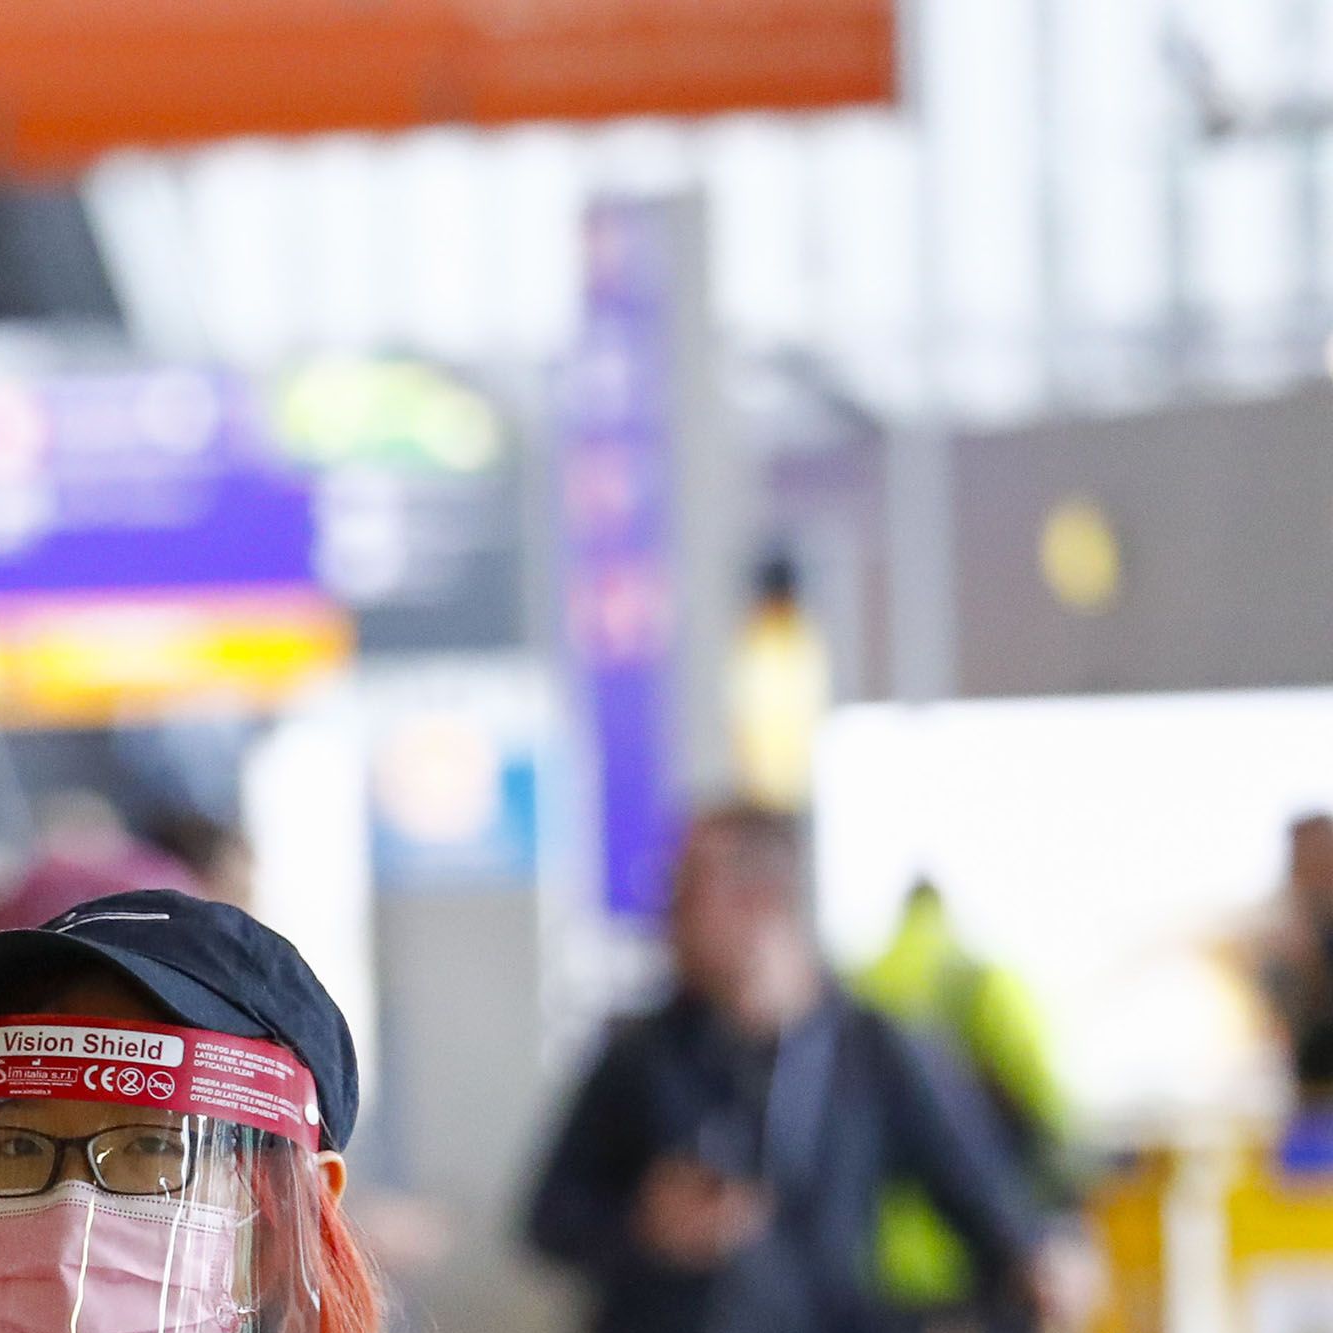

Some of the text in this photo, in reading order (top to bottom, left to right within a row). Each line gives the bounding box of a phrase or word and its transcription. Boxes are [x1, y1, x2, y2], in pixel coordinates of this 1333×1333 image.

[4, 1032, 164, 1060] Vision Shield
[193, 1059, 255, 1078] OPTICALLY CLEAR
